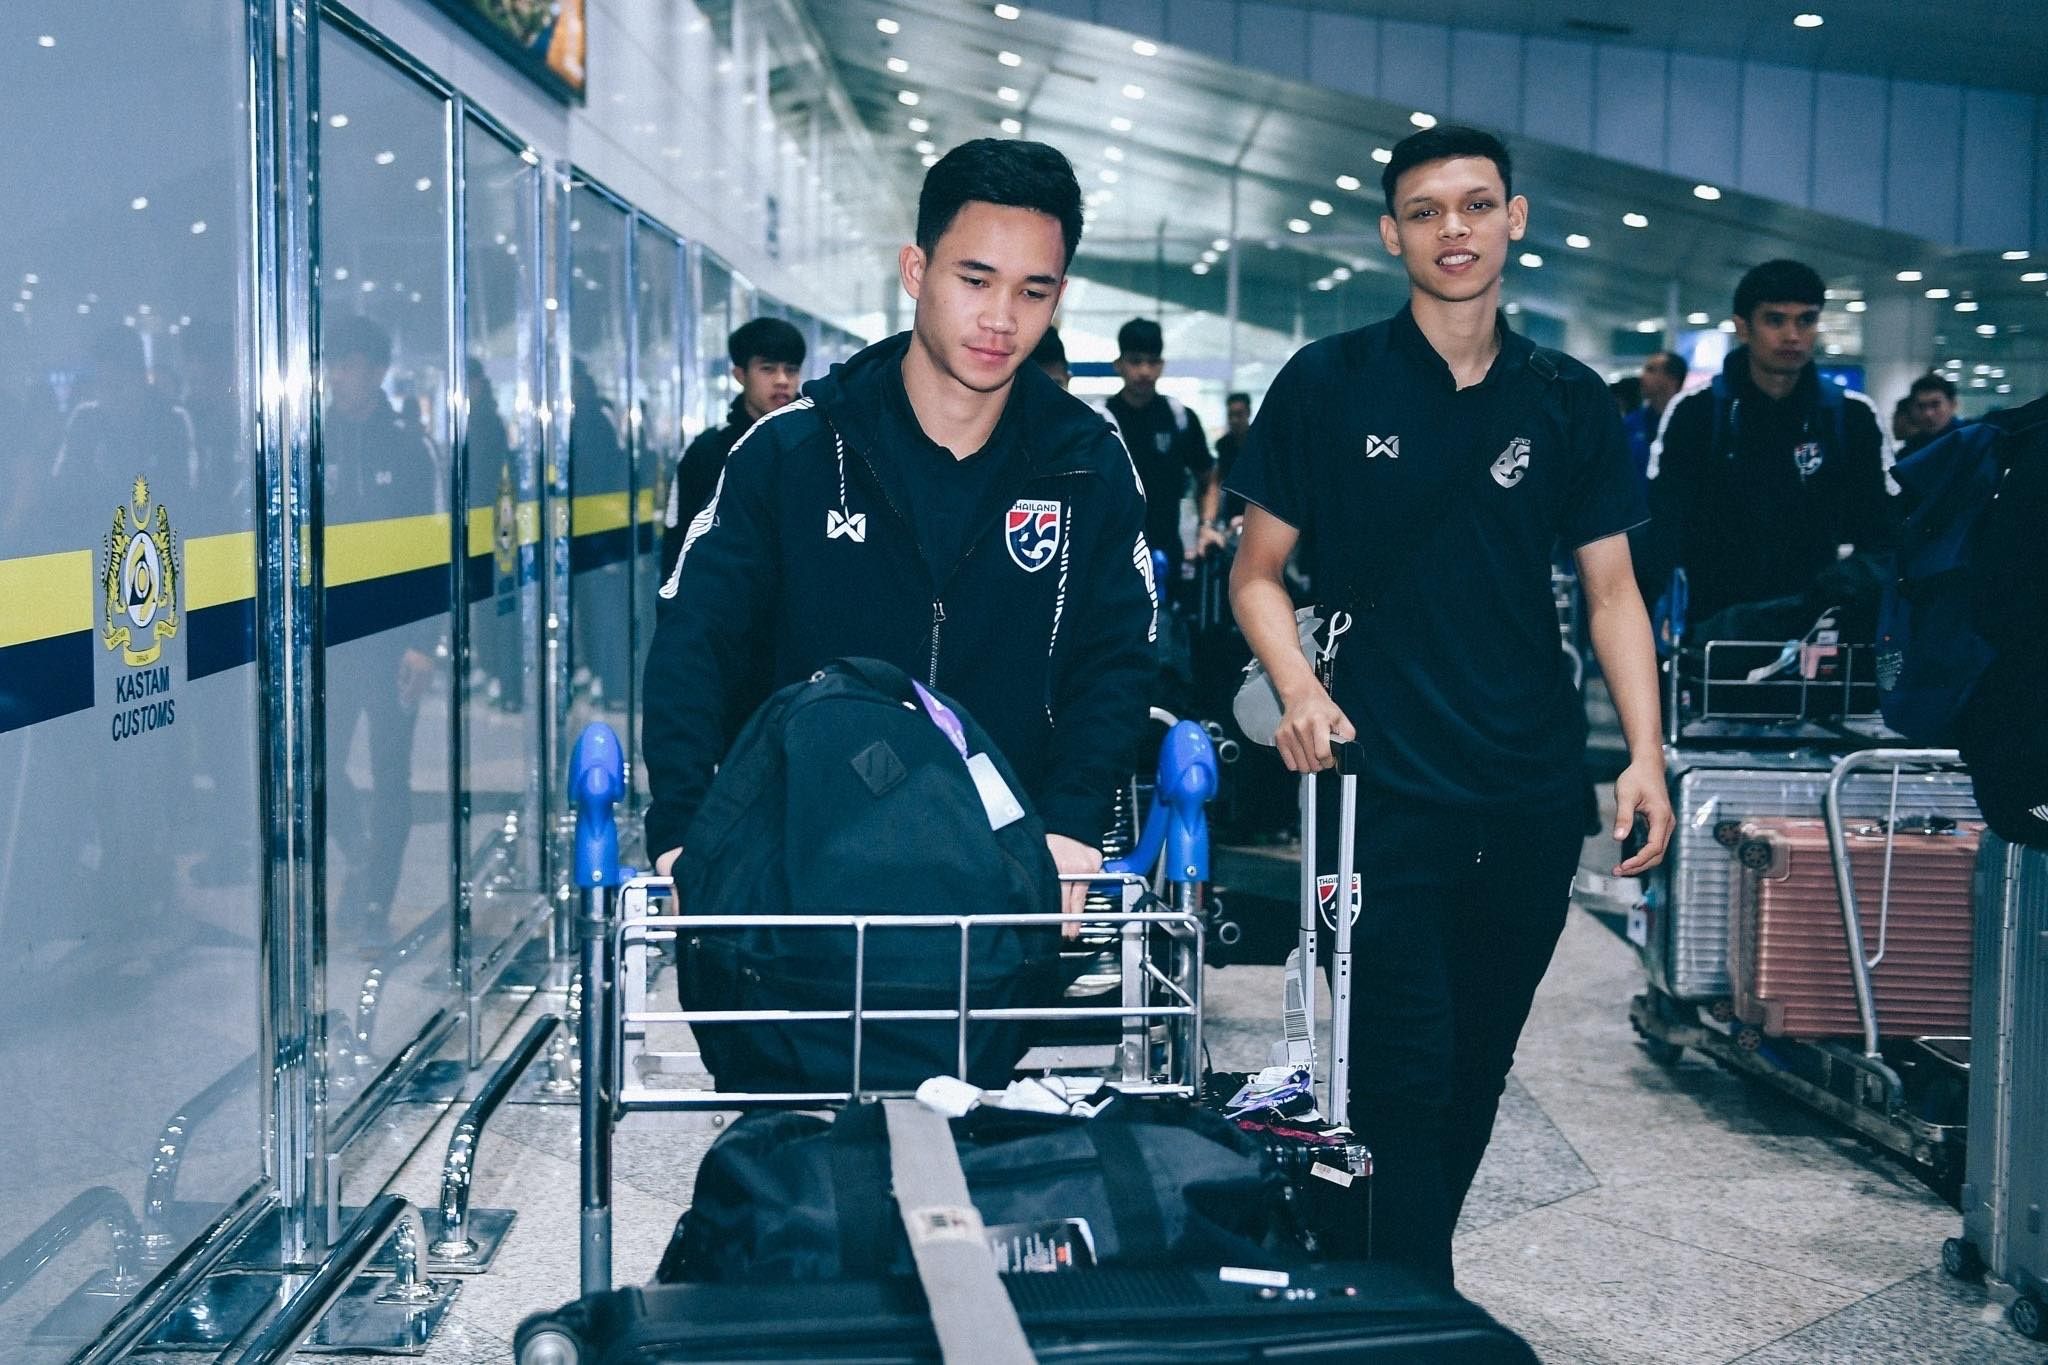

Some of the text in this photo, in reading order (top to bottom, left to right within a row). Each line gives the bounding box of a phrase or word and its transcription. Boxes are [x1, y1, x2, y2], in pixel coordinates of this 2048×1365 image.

[1015, 503, 1057, 512] HAILAND
[116, 666, 170, 704] KASTAM
[112, 699, 176, 742] CUSTOMS
